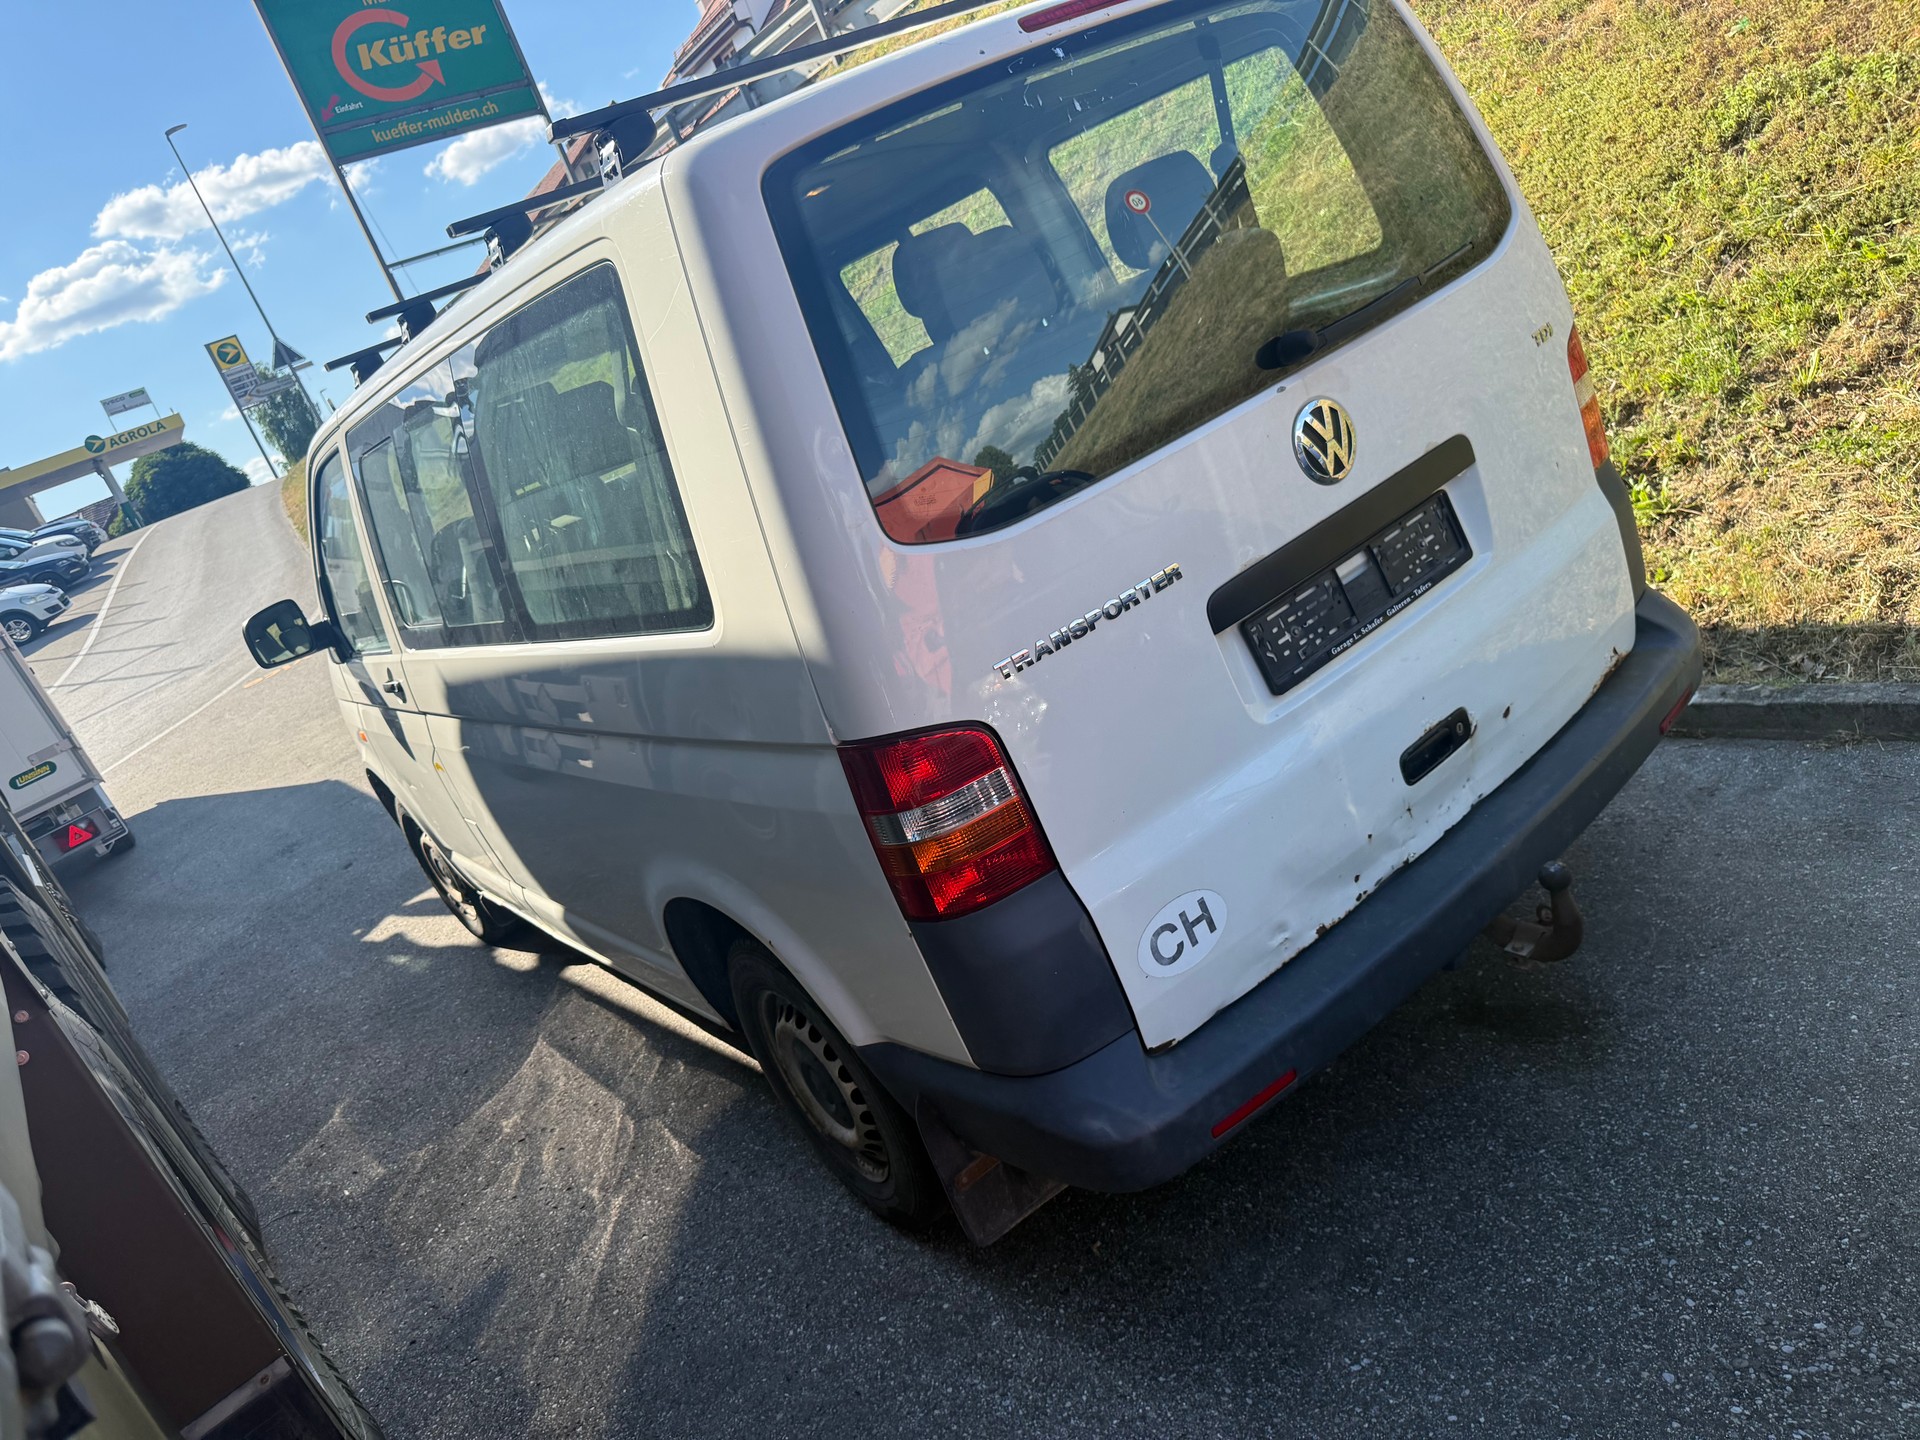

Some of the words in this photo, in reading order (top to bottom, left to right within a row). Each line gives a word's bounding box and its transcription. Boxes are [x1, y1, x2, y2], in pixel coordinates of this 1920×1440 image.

[357, 24, 487, 71] Küffer
[335, 102, 363, 113] Einfahrt
[371, 101, 499, 143] kueffer-mulden.ch
[109, 421, 167, 449] AGROLA
[992, 562, 1184, 680] TRANSPORTER
[1331, 637, 1354, 656] Garage
[1353, 632, 1361, 640] L.
[1386, 596, 1411, 617] Galteren
[1413, 581, 1432, 597] Tafers
[1150, 897, 1217, 966] CH
